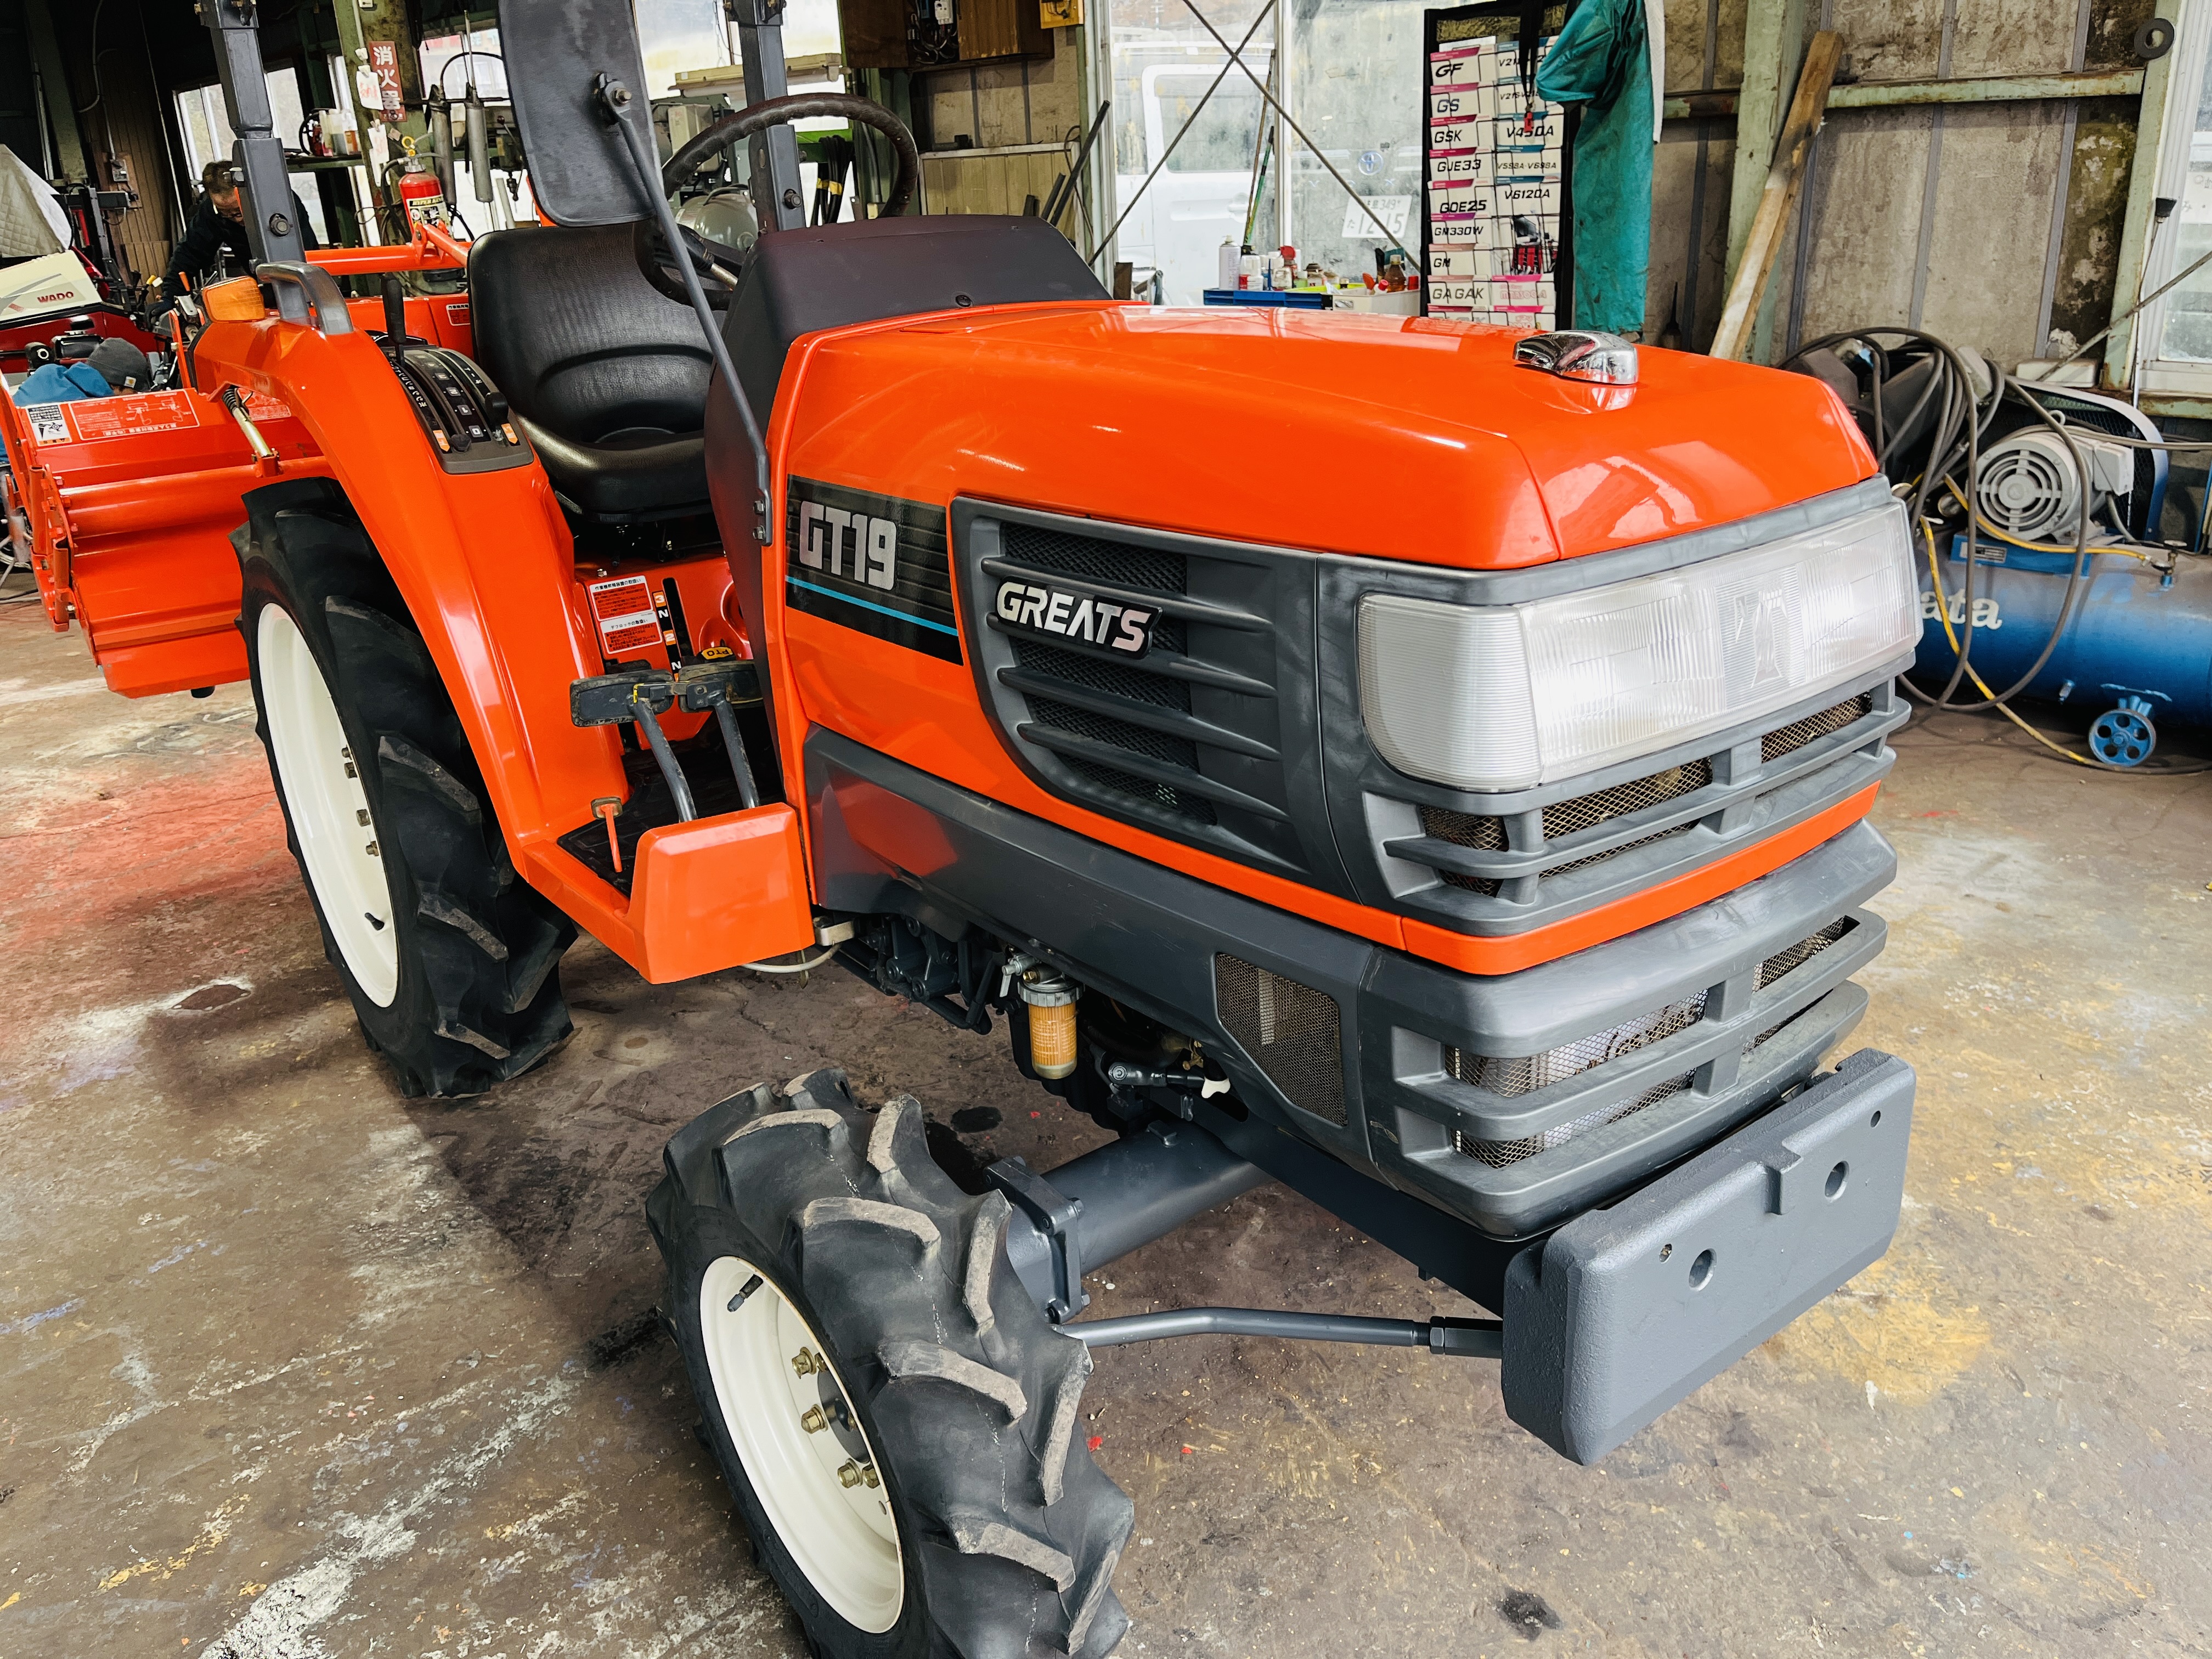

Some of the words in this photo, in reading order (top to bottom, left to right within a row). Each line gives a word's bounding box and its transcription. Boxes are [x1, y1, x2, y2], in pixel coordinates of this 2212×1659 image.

[1435, 63, 1464, 77] GF
[373, 46, 402, 110] 消火器
[1437, 99, 1460, 113] GS
[1435, 129, 1463, 144] GSK
[1437, 159, 1481, 172] GJE33
[1504, 189, 1550, 200] V6120A
[37, 291, 75, 304] WADO
[1432, 289, 1452, 299] GA
[1455, 287, 1484, 299] GAK
[799, 500, 897, 591] GT19
[654, 595, 665, 603] 3
[658, 609, 669, 618] N
[1921, 588, 2003, 630] ata
[997, 581, 1152, 652] GREATS
[664, 634, 675, 642] 2
[707, 648, 730, 657] PTO
[672, 661, 682, 670] N
